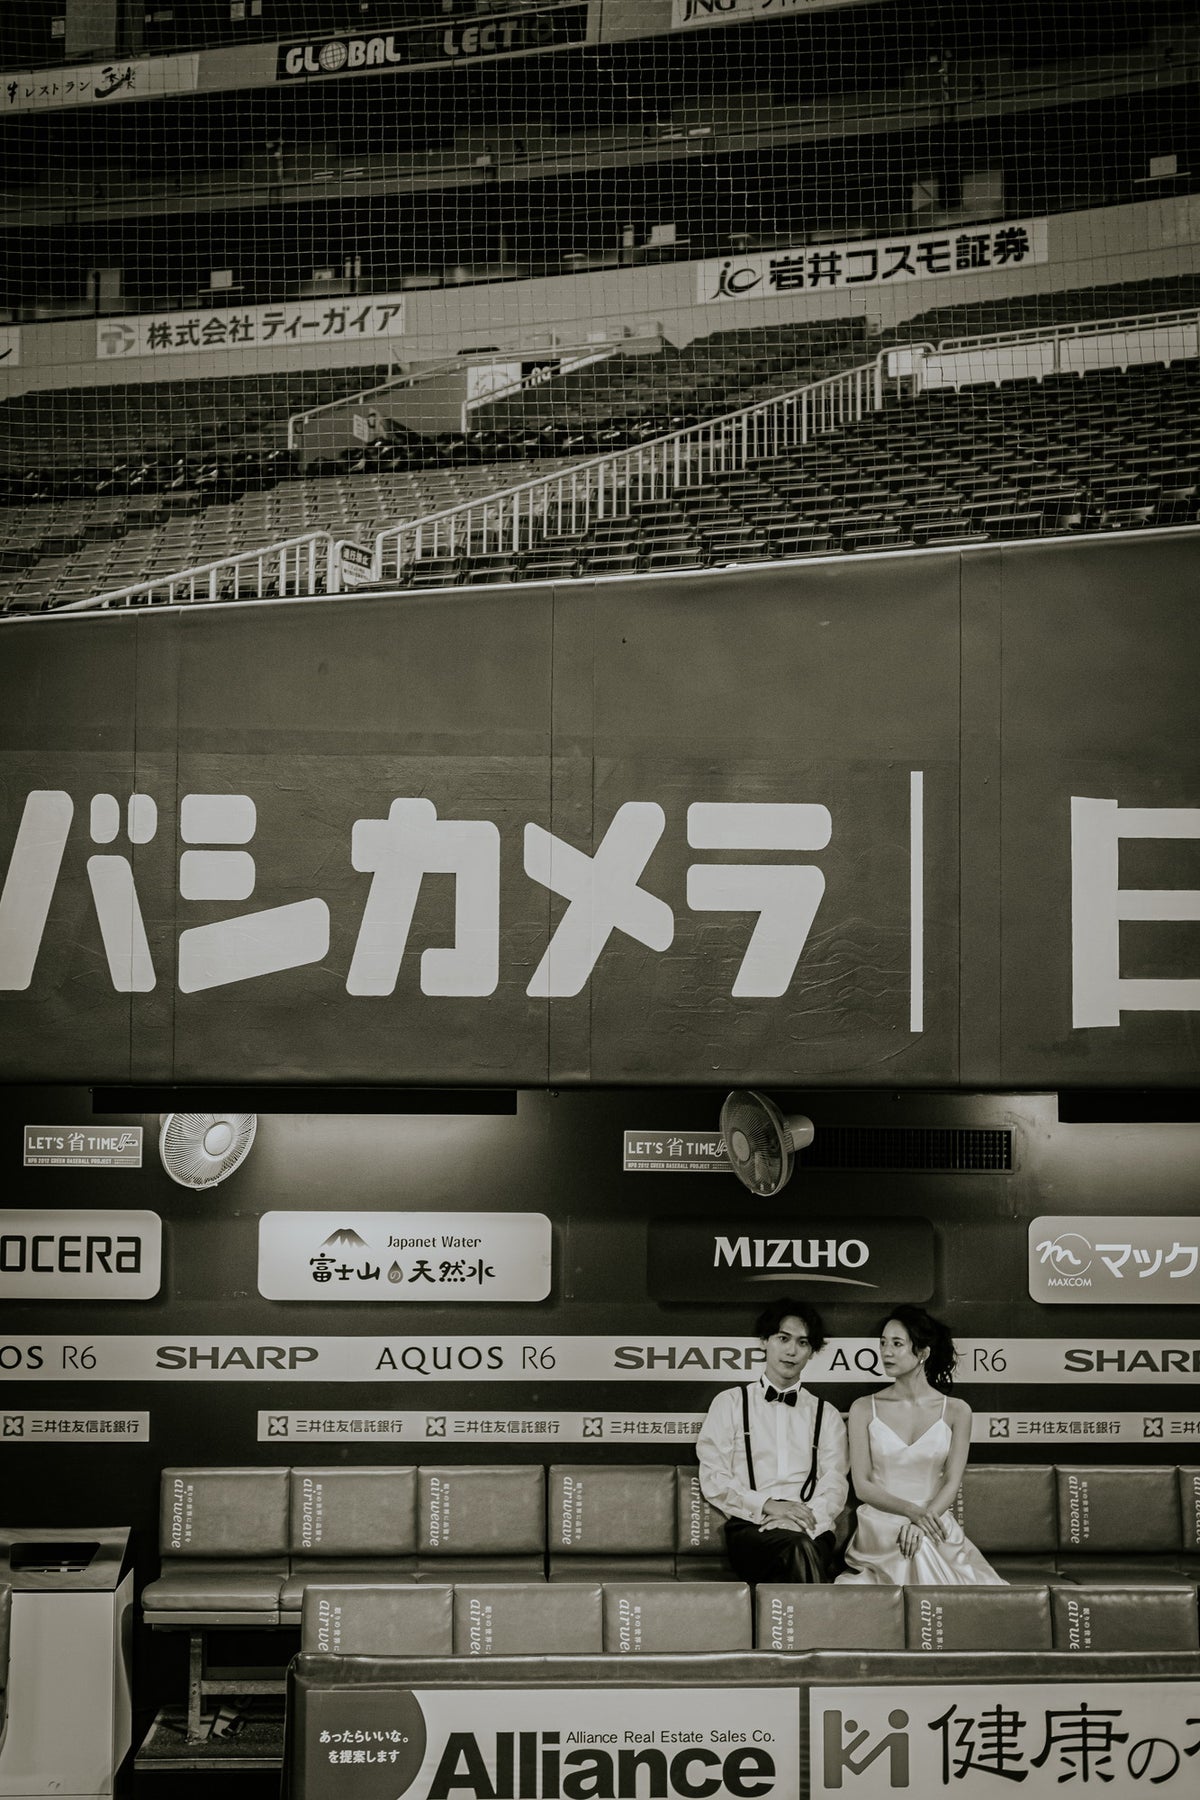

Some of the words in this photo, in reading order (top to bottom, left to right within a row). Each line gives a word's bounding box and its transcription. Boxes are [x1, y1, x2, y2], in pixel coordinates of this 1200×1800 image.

[285, 36, 401, 74] GLOBAL
[769, 226, 1030, 291] 岩井コスモ証券
[0, 790, 832, 997] バシカメラ
[28, 1137, 64, 1150] LET'S
[88, 1137, 118, 1150] TIME
[628, 1142, 664, 1154] LET'S
[686, 1143, 716, 1155] TIME
[387, 1236, 437, 1250] Japanet
[441, 1236, 482, 1248] Water
[713, 1236, 870, 1268] MIZUHO
[1095, 1242, 1199, 1278] マック
[1048, 1278, 1092, 1287] MAXCOM
[62, 1346, 97, 1369] R6
[155, 1346, 319, 1370] SHARP
[375, 1346, 504, 1375] AQUOS
[522, 1346, 556, 1370] R6
[973, 1348, 1007, 1372] R6
[30, 1420, 139, 1434] 三井住友信託銀行
[295, 1420, 403, 1434] 三井住友信託銀行
[453, 1420, 561, 1434] 三井住友信託銀行
[1016, 1421, 1121, 1434] 三井住友信託銀行
[171, 1479, 188, 1548] airweave
[302, 1478, 317, 1547] airweave
[429, 1477, 444, 1546] airweave
[562, 1476, 577, 1545] airweave
[1068, 1476, 1082, 1544] airweave
[319, 1730, 409, 1743] あったらいいな。
[566, 1730, 618, 1744] Alliance
[624, 1730, 655, 1744] Real
[660, 1730, 704, 1744] Estate
[710, 1730, 747, 1743] Sales
[752, 1729, 776, 1743] Co.
[328, 1749, 400, 1763] を提案します
[426, 1731, 776, 1800] Alliance
